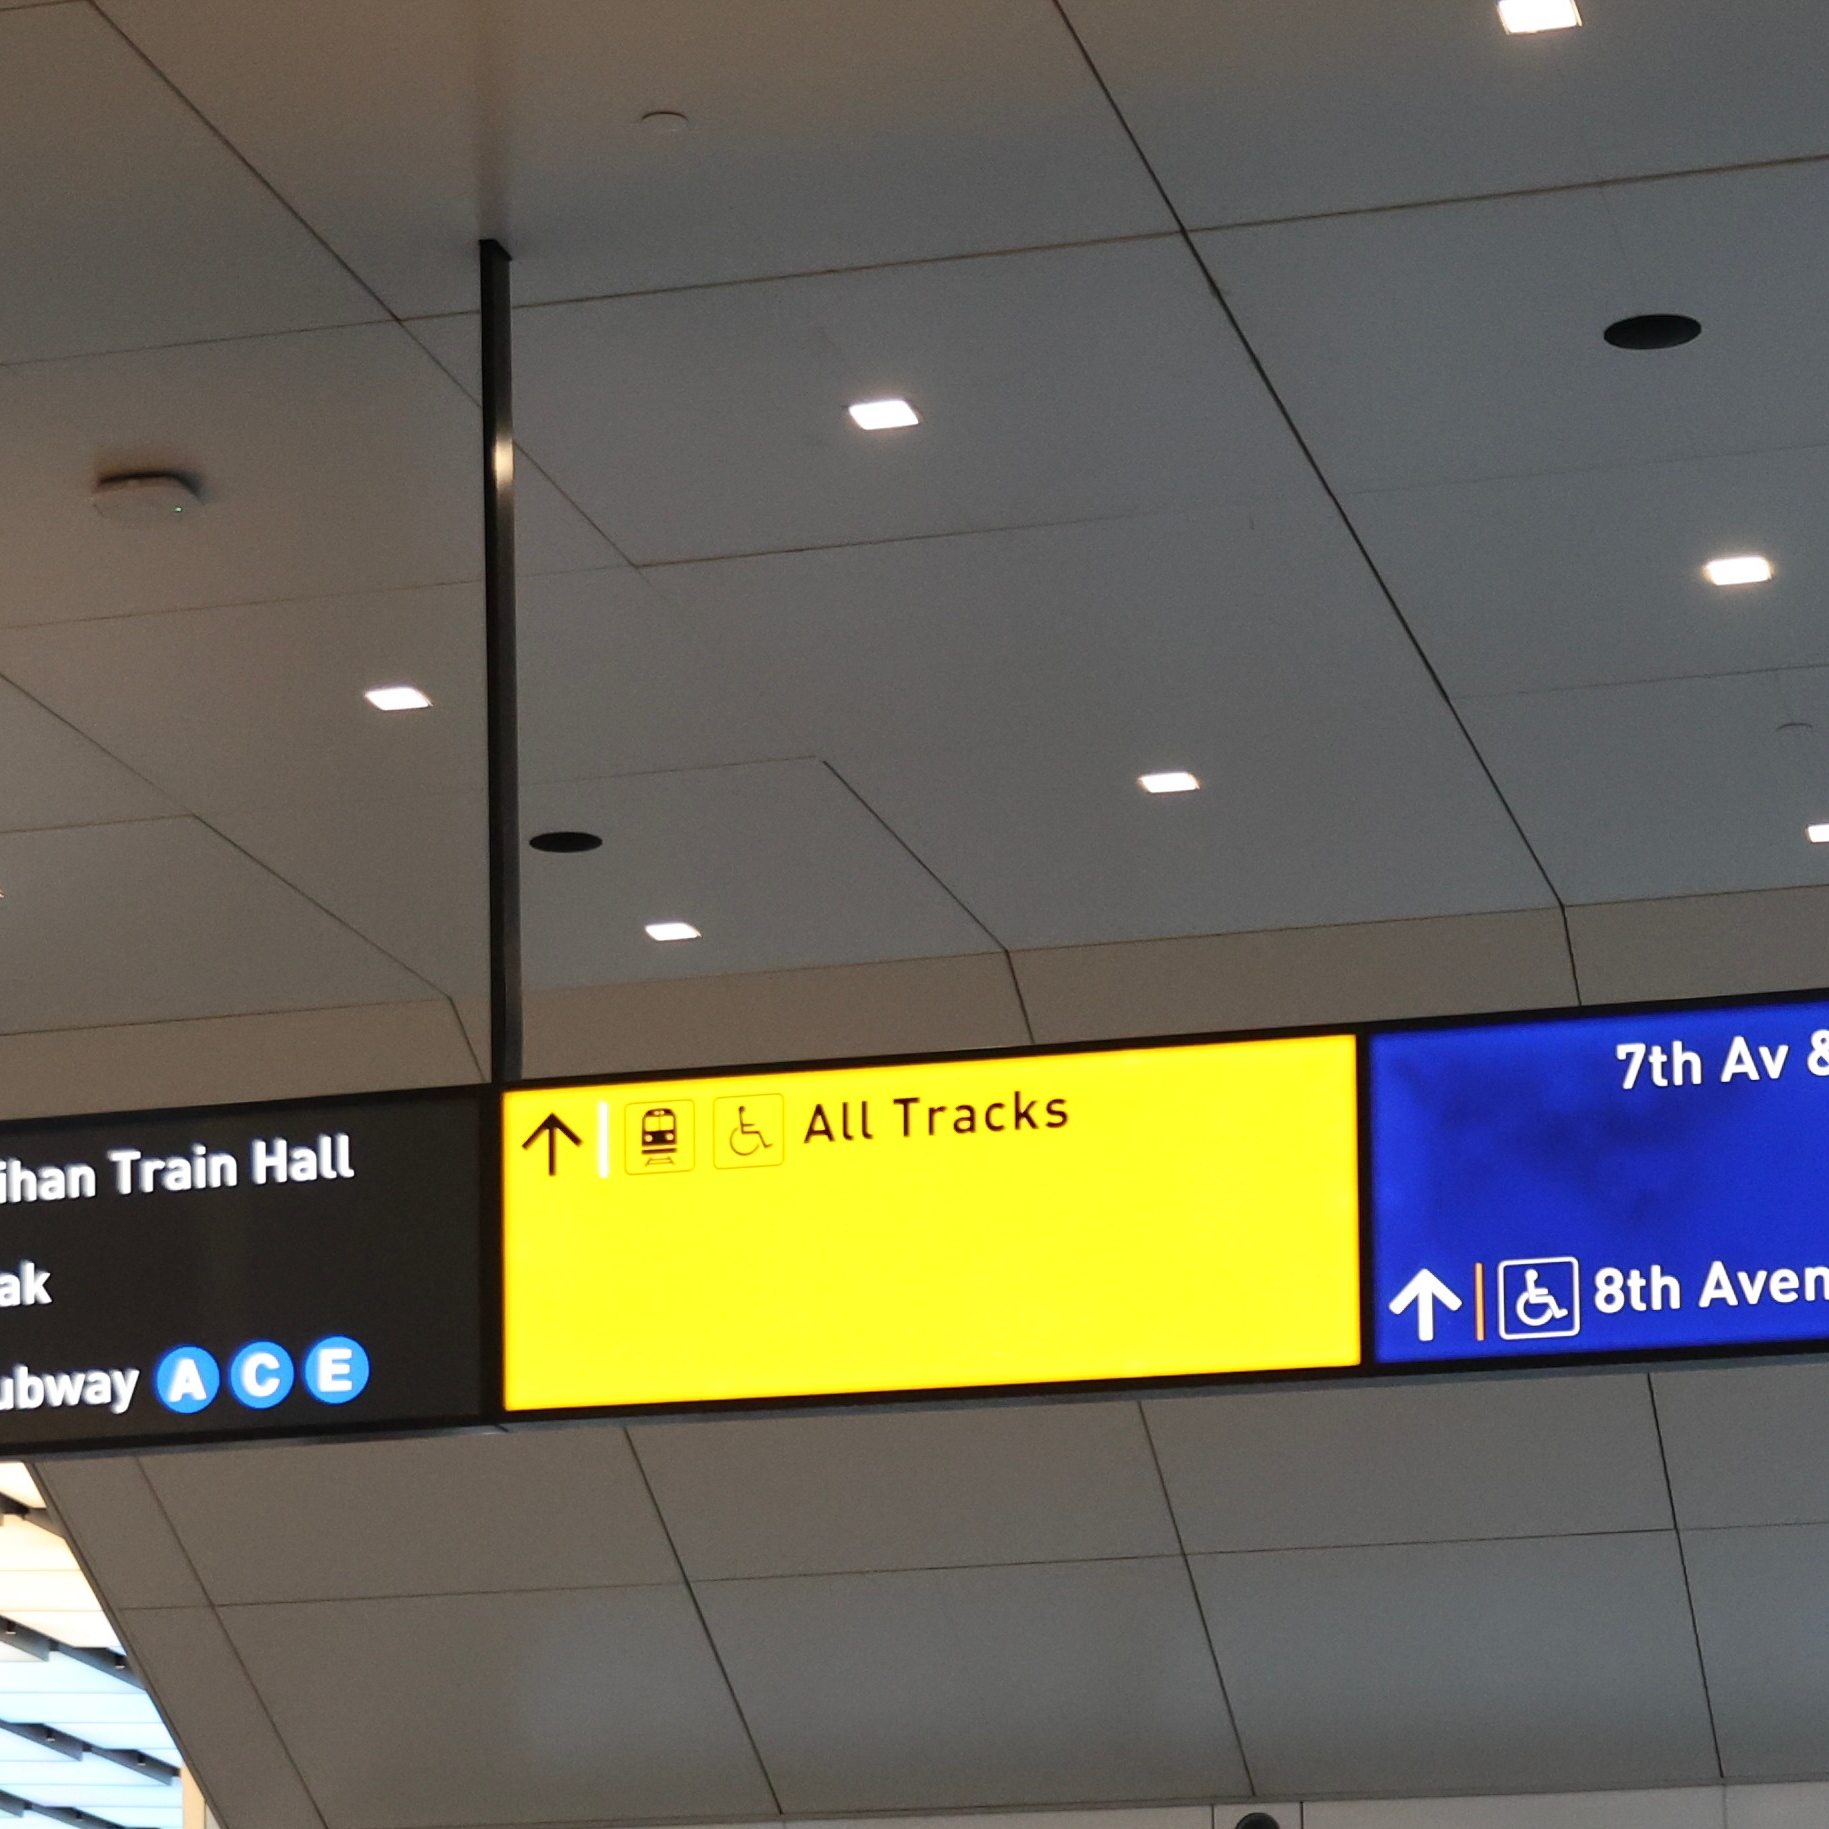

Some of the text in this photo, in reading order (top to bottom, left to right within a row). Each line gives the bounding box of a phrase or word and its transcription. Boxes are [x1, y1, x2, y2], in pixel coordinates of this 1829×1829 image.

[1616, 1040, 1702, 1090] 7th
[1721, 1036, 1784, 1083] Av
[804, 1091, 1069, 1143] All Tracks
[108, 1144, 238, 1195] Train
[251, 1133, 355, 1185] Hall
[1594, 1264, 1681, 1314] 8th
[167, 1357, 207, 1403] A
[241, 1351, 281, 1398] C
[317, 1347, 353, 1393] E
